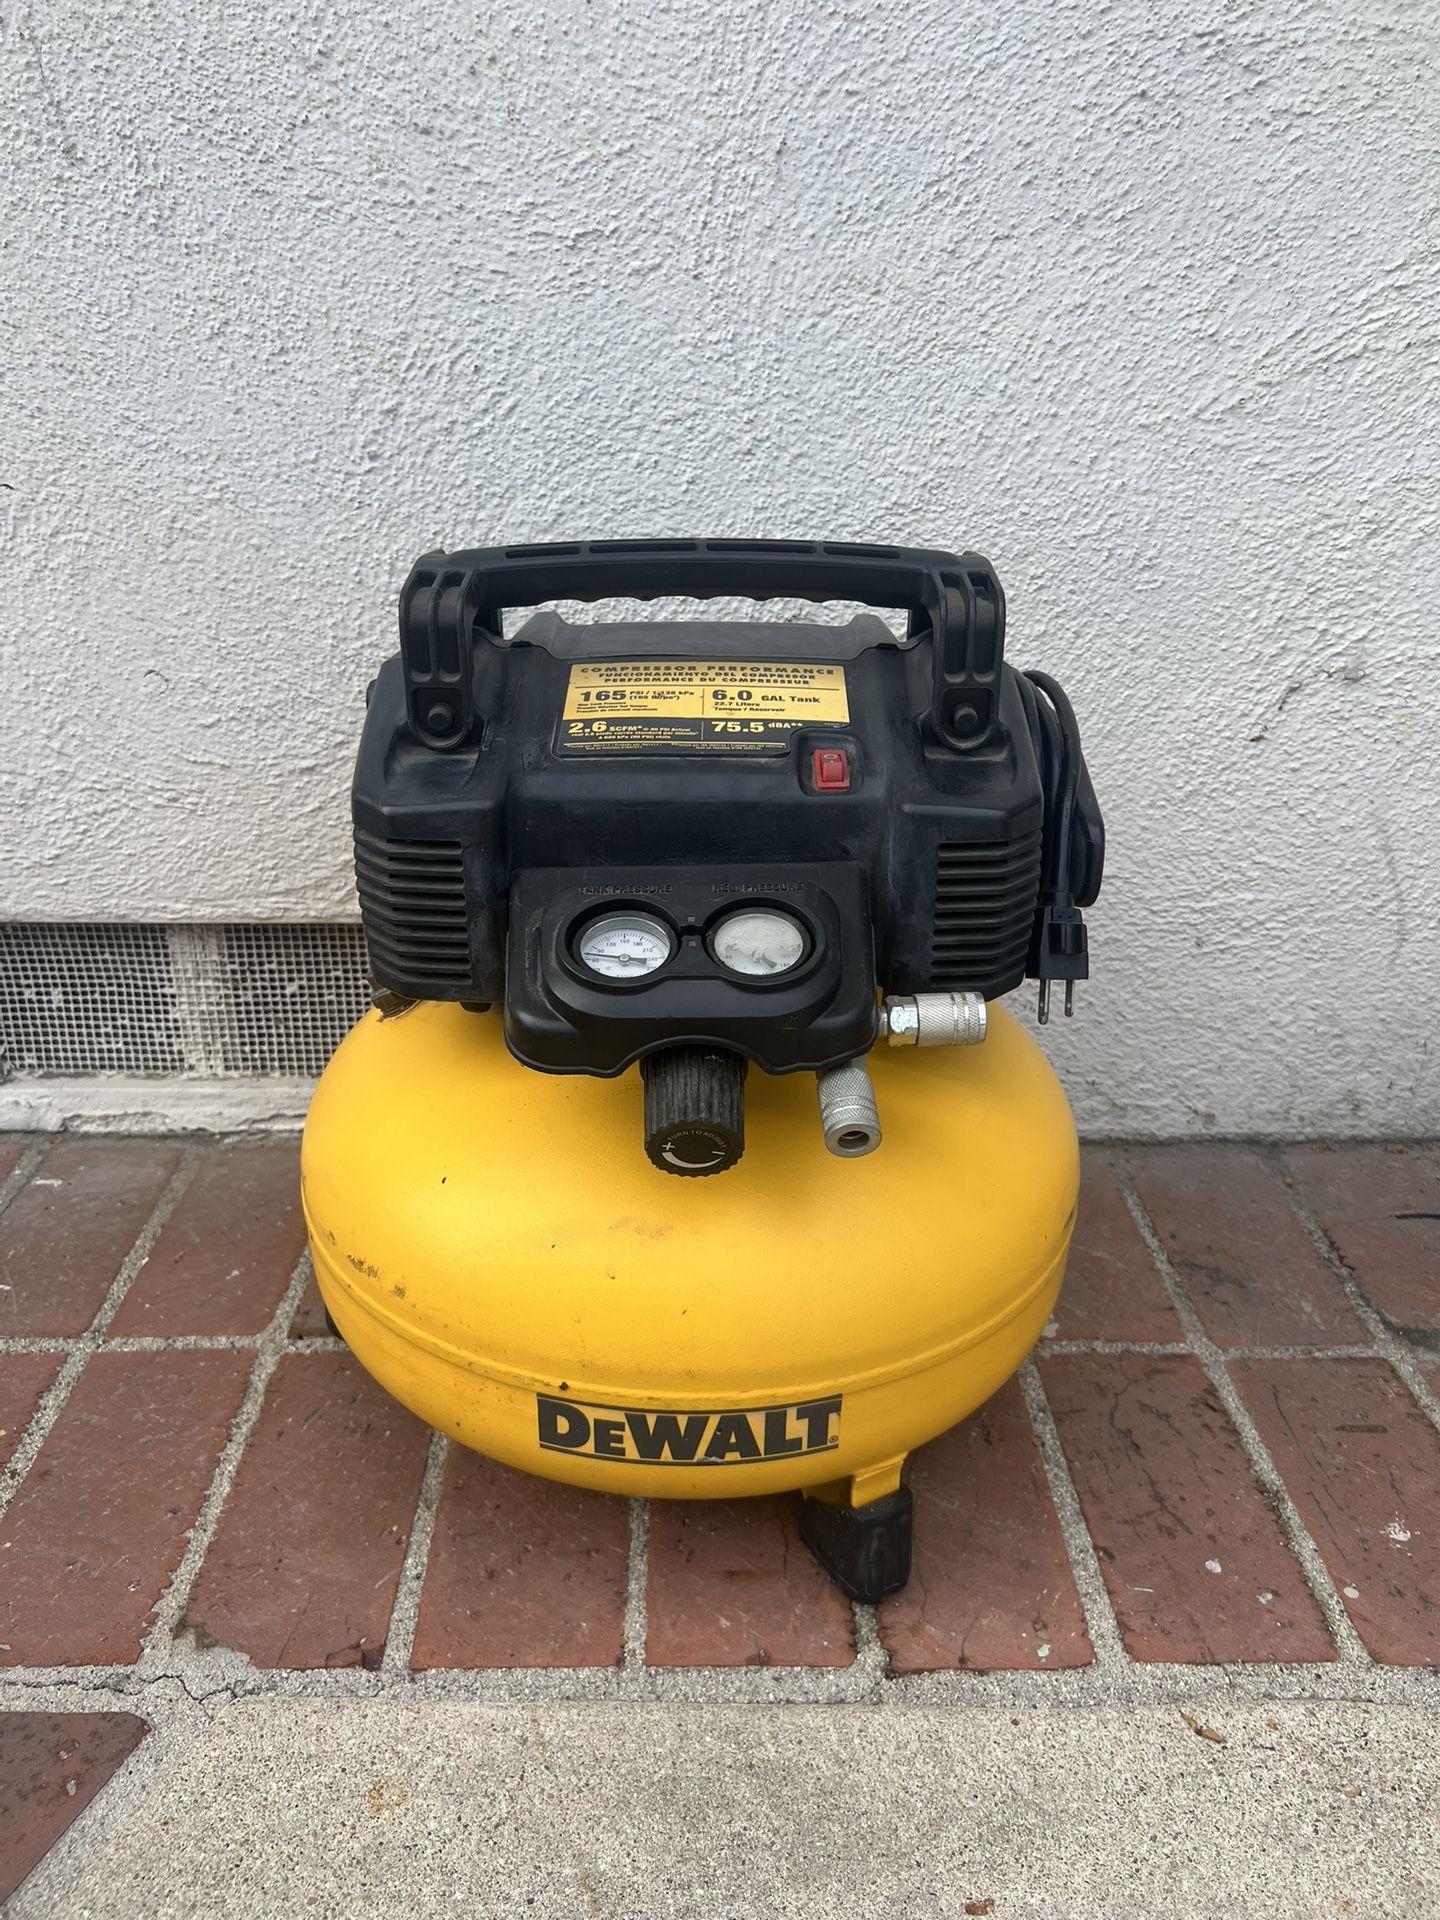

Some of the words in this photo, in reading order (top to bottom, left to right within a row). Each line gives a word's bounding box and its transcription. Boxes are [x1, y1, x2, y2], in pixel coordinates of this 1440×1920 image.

[581, 665, 697, 674] COMPRESSOR
[707, 665, 834, 675] PERFORMANCE
[722, 677, 810, 685] COMPRESSEUR
[742, 672, 816, 680] COMPRESOR
[580, 690, 627, 702] 165
[712, 689, 753, 701] 6.0
[568, 721, 608, 733] 2.6
[711, 721, 765, 733] 75.5
[612, 884, 673, 894] PRESSURE
